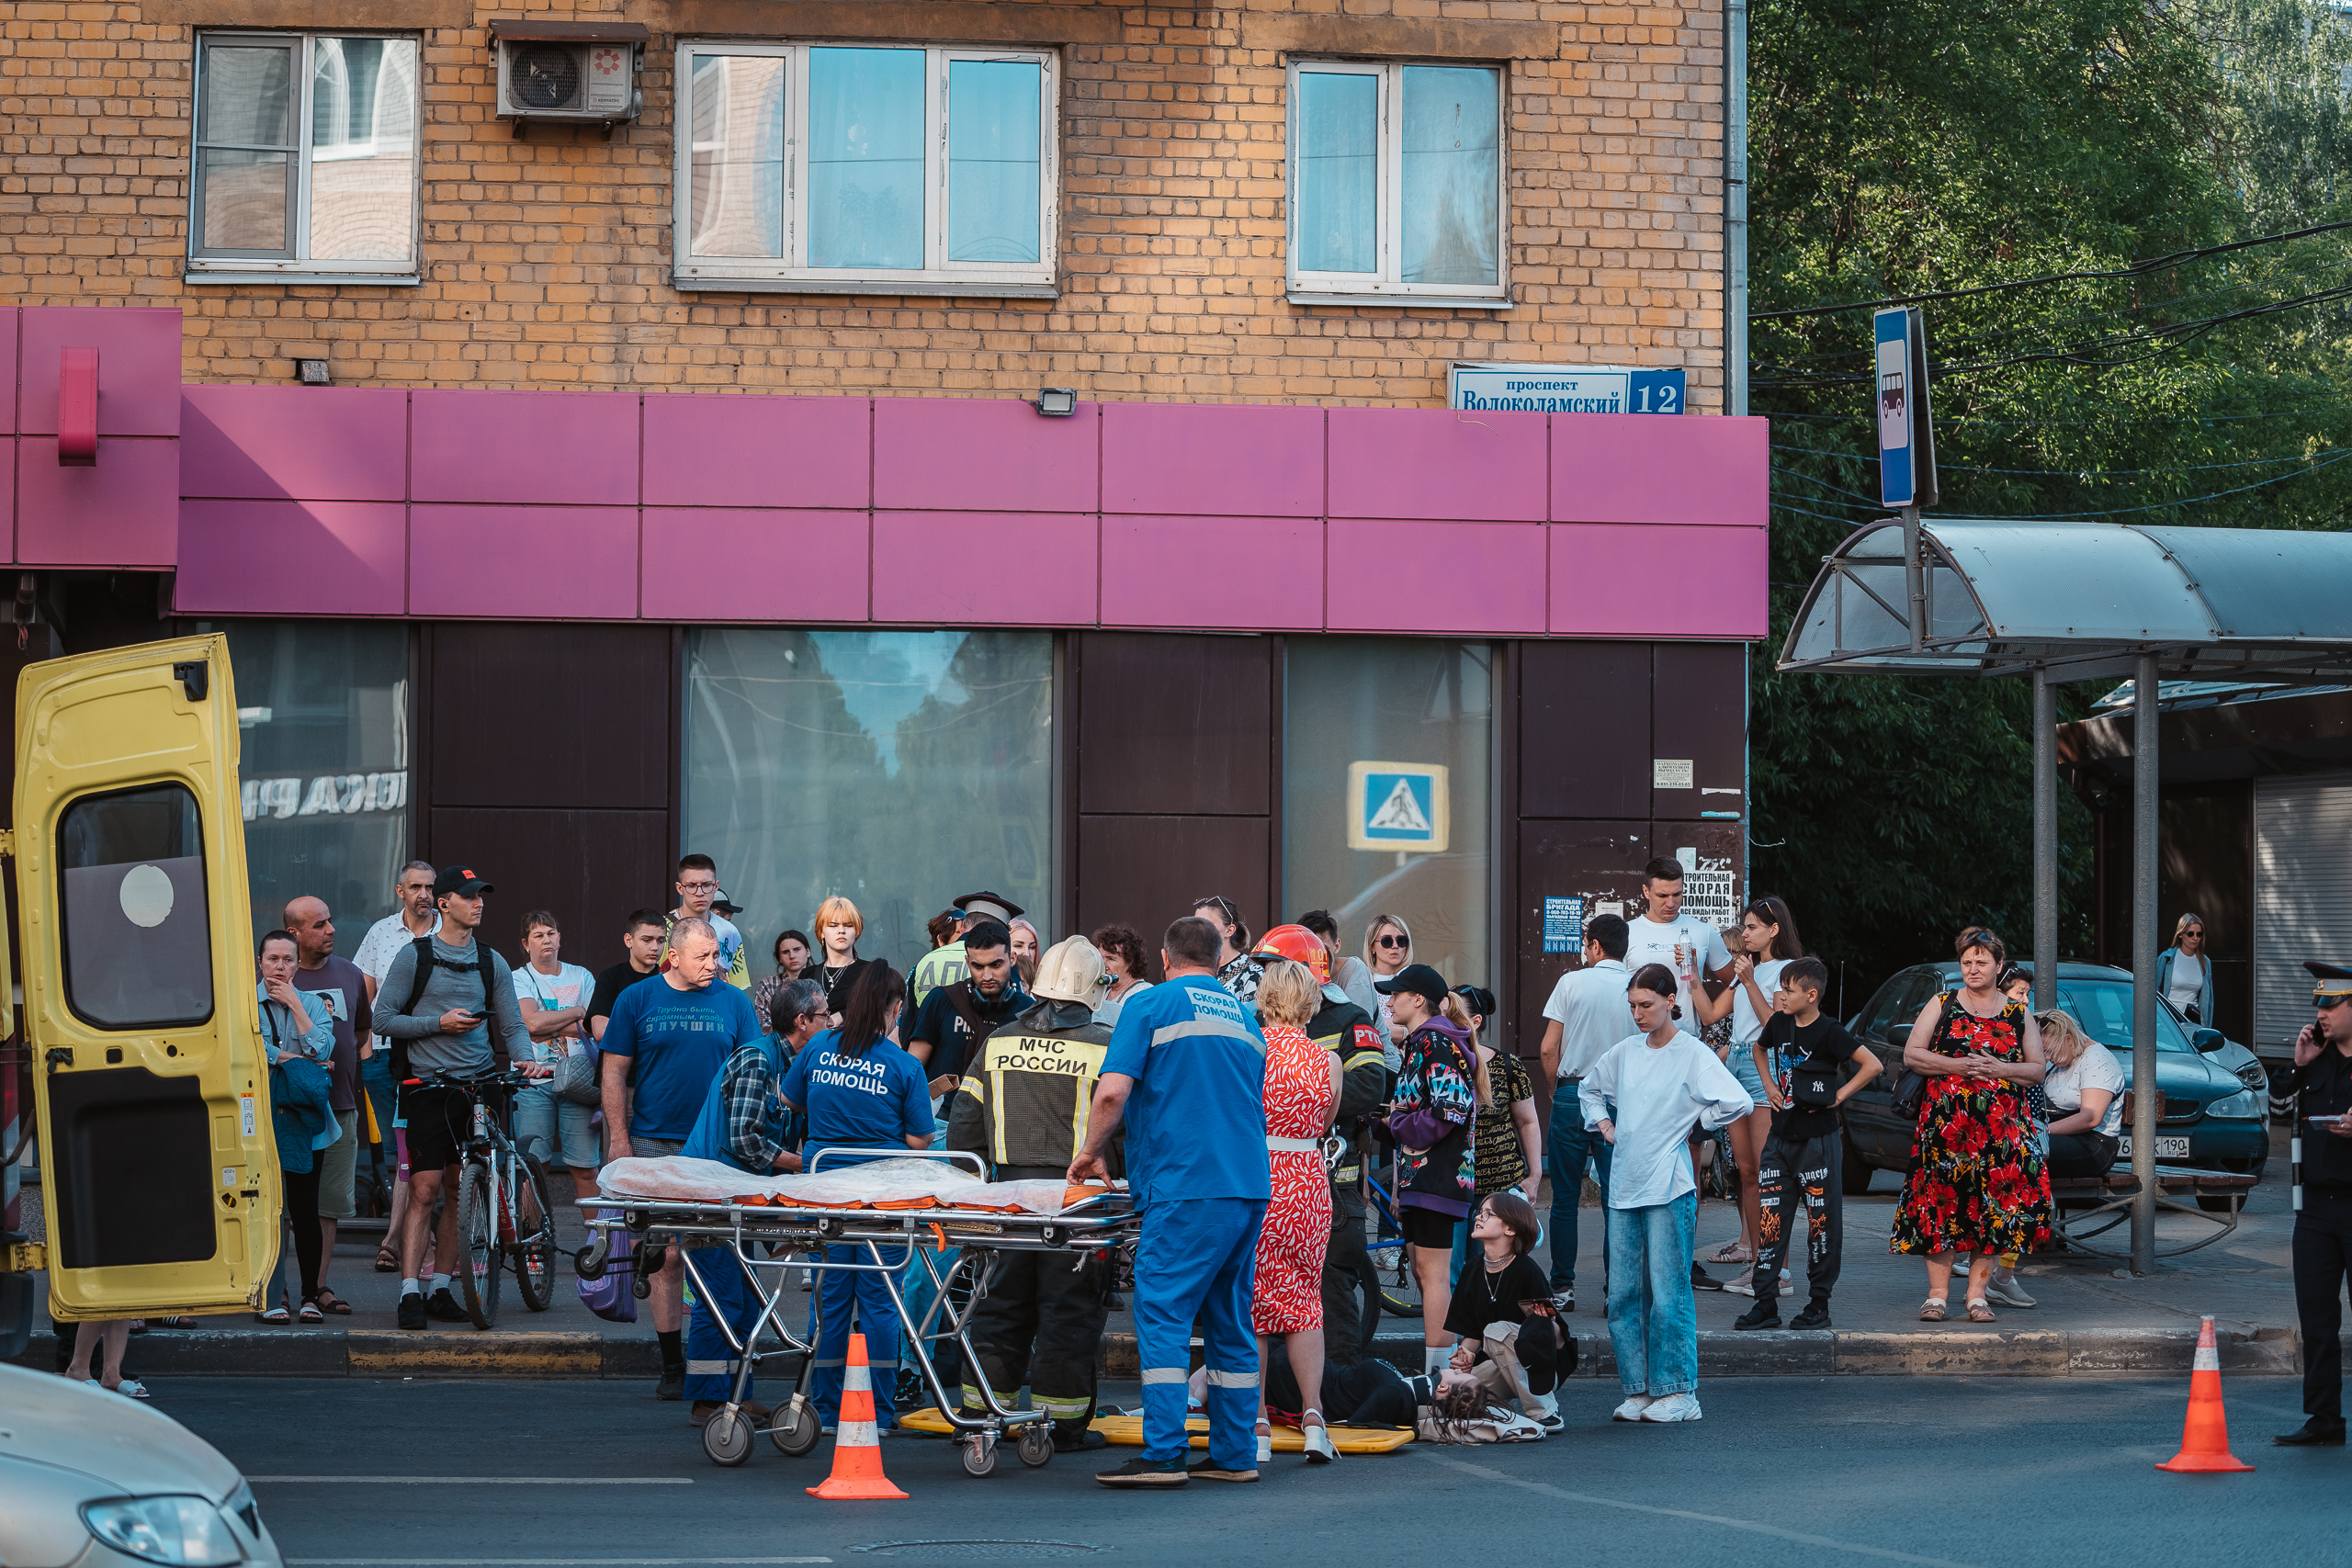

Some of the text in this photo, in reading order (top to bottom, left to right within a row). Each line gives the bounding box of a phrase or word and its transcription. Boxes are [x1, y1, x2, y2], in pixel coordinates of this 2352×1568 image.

[1506, 381, 1578, 391] проспект
[1463, 390, 1621, 413] Волоколамский
[1637, 385, 1677, 413] 12
[1685, 873, 1730, 882] ТРОИТЕЛЬНАЯ
[1683, 883, 1730, 895] СКОРАЯ
[1192, 993, 1236, 1009] СКОРАЯ
[646, 1015, 724, 1023] скромным, когда
[1192, 1004, 1244, 1024] ПОМОЩЬ
[1019, 1038, 1066, 1054] МЧС
[819, 1052, 886, 1078] СКОРАЯ
[997, 1055, 1087, 1075] РОССИИ
[812, 1069, 888, 1095] ПОМОЩЬ
[2163, 1139, 2185, 1150] 190
[1758, 1167, 1828, 1186] Palm Angels
